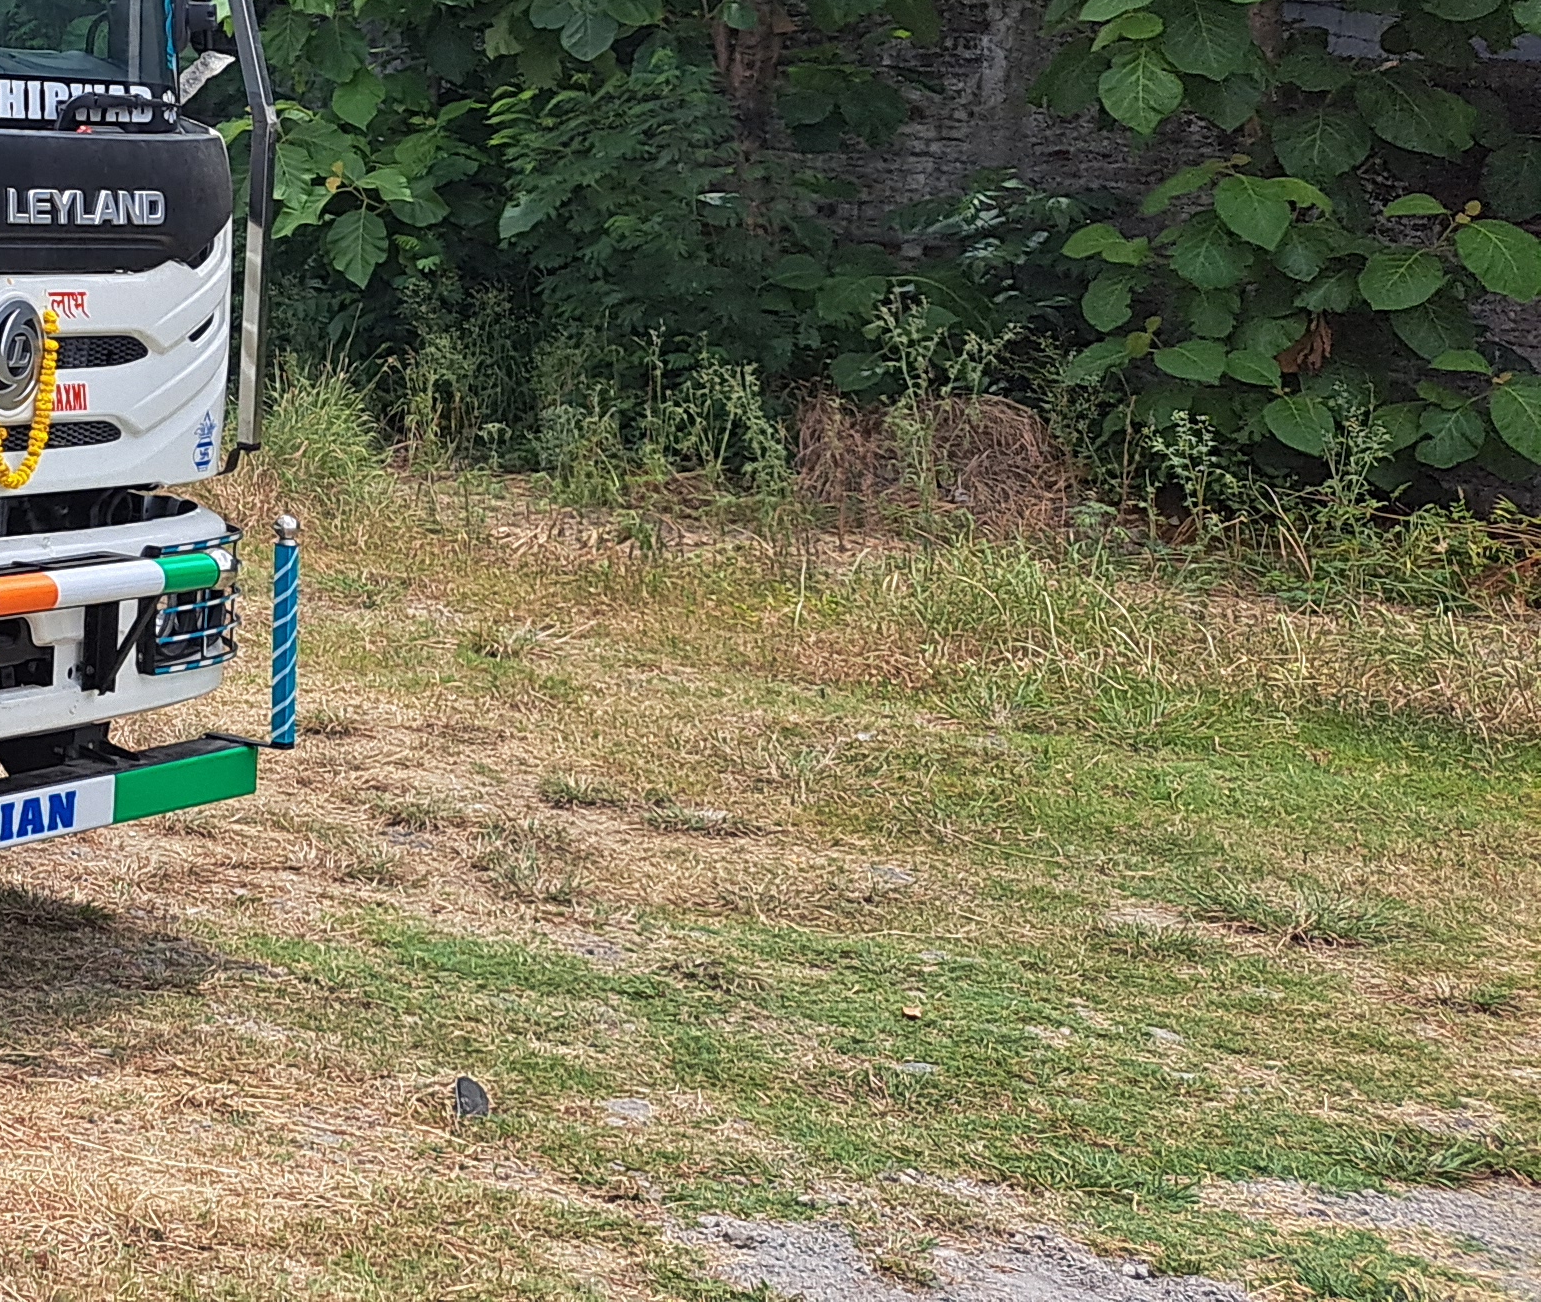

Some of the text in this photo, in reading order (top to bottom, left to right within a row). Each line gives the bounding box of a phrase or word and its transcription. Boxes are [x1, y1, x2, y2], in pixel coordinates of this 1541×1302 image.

[6, 187, 166, 226] LEYLAND
[47, 291, 90, 319] लाभ
[51, 382, 89, 412] AXMI
